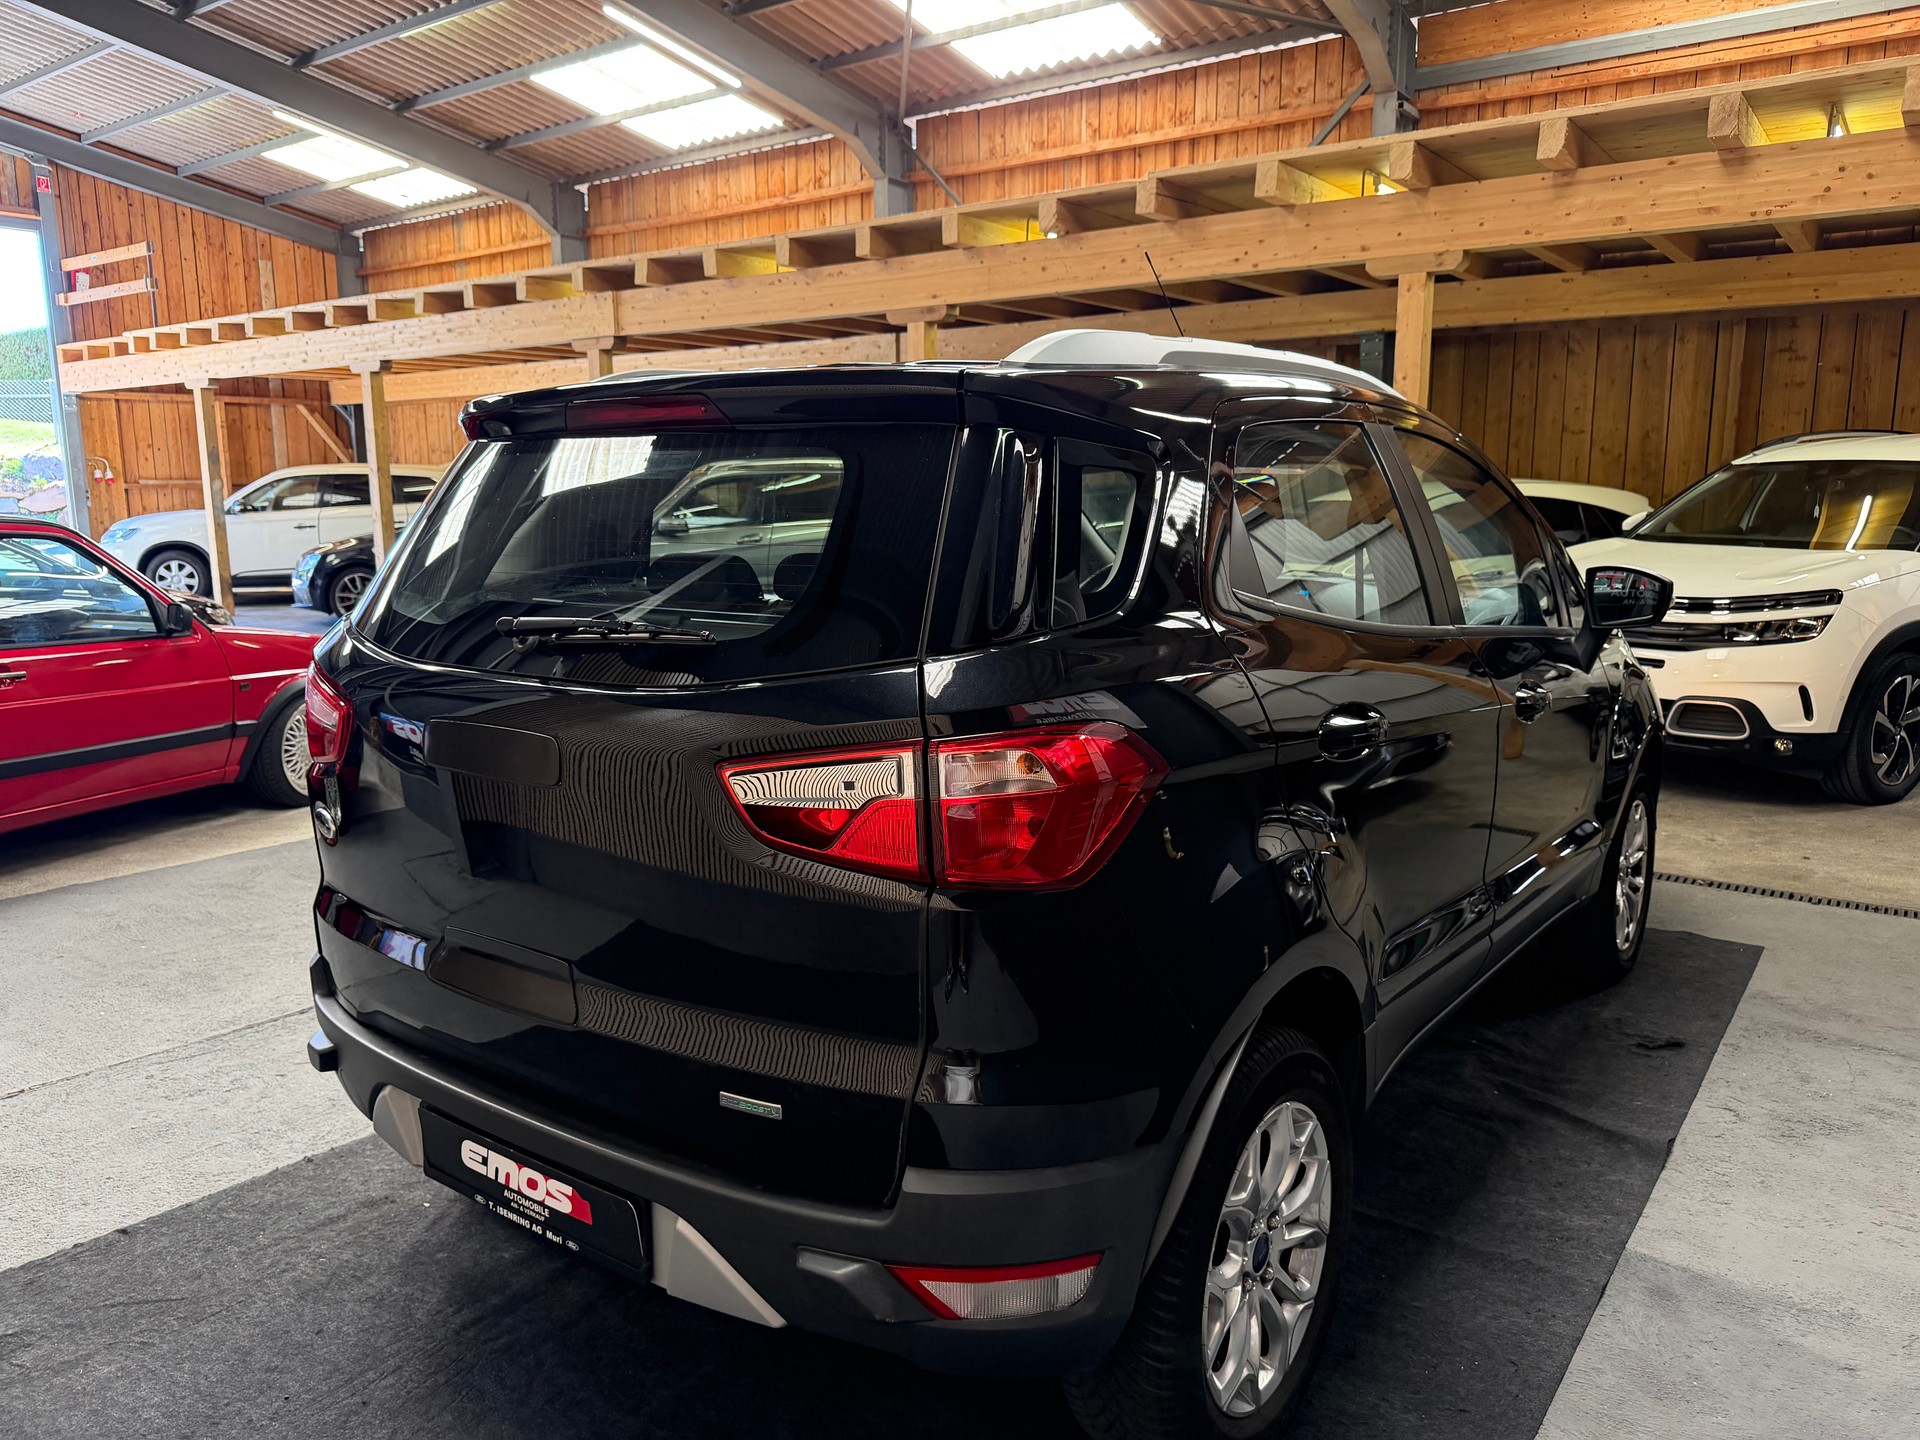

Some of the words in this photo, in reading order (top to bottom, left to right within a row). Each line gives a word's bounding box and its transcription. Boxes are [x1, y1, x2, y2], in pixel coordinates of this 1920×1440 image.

[461, 1139, 573, 1214] EMOS
[503, 1189, 550, 1218] AUTOMOBILE
[524, 1208, 545, 1222] VERKAUF
[488, 1201, 496, 1211] T.
[496, 1205, 531, 1229] ISENRING
[531, 1223, 543, 1235] AG
[546, 1229, 563, 1244] Muri
